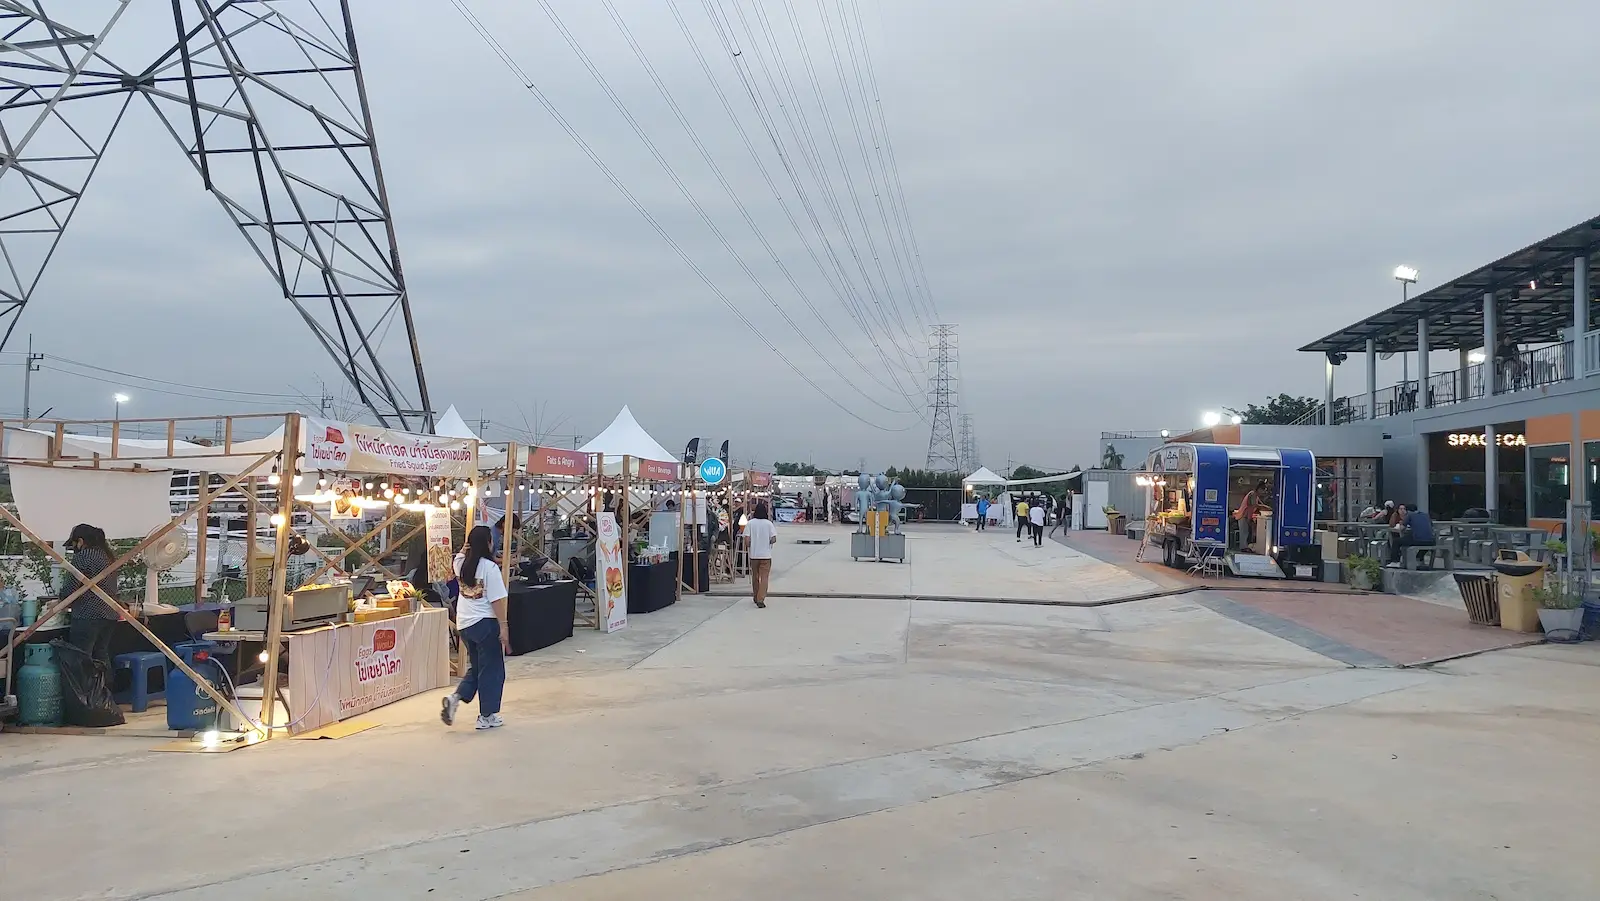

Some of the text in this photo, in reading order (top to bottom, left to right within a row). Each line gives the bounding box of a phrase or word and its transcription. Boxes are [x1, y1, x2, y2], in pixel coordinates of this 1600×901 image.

[389, 459, 406, 469] Fried
[406, 460, 424, 472] Squid
[647, 464, 655, 473] Food
[703, 466, 721, 477] WUA
[358, 647, 373, 660] Eggs
